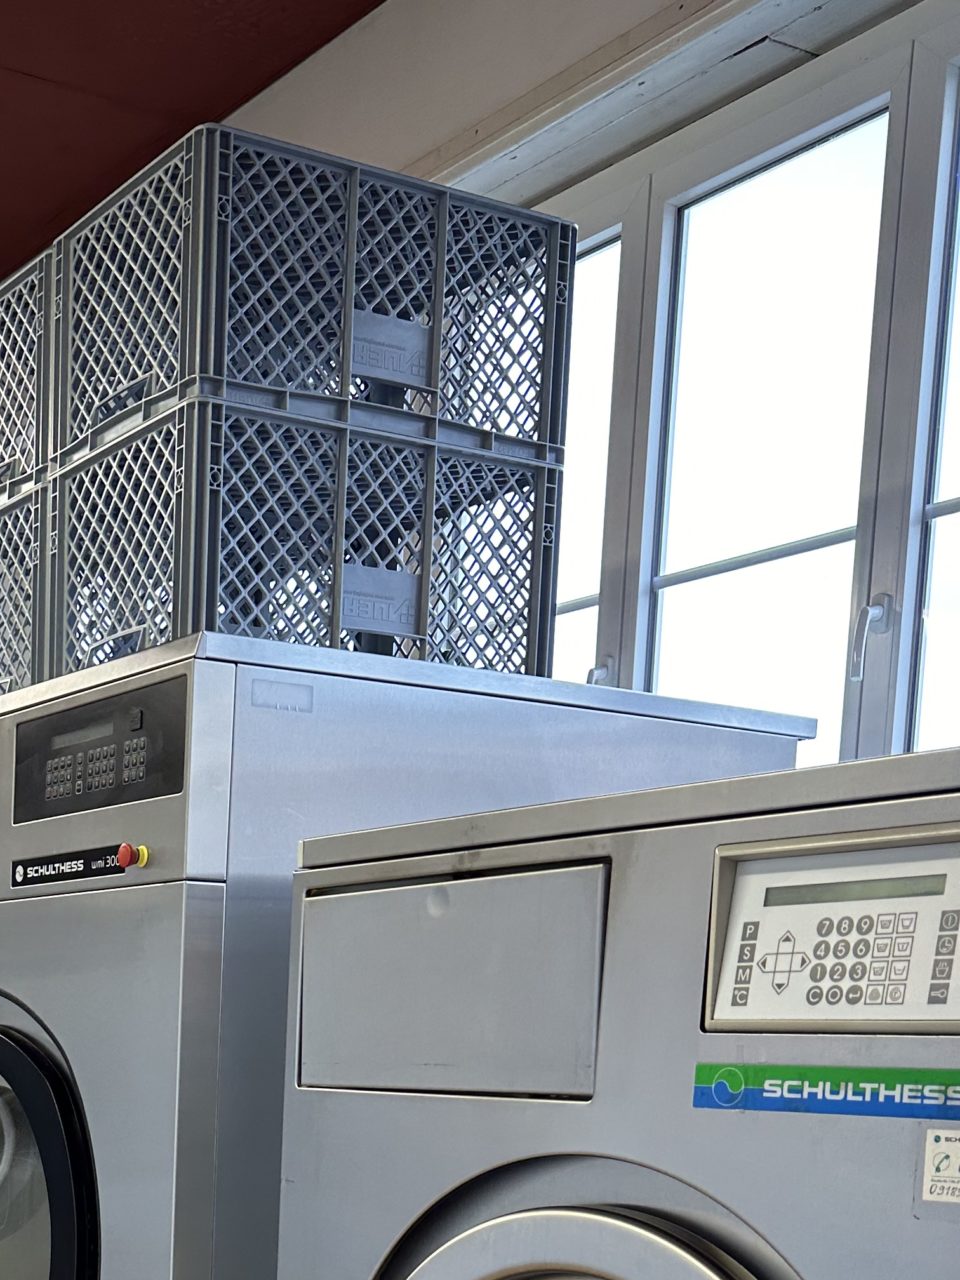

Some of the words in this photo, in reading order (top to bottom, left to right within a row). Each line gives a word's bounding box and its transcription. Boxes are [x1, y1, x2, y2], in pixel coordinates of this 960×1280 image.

[27, 860, 84, 878] SCHULTHESS
[746, 925, 755, 936] P
[822, 921, 829, 933] 7
[842, 920, 849, 932] 8
[861, 919, 869, 932] 9
[743, 948, 750, 960] S
[817, 944, 825, 957] 4
[837, 943, 846, 956] 5
[857, 942, 865, 955] 6
[737, 969, 749, 980] M
[834, 966, 842, 978] 2
[854, 965, 862, 978] 3
[809, 990, 820, 1001] C
[763, 1079, 960, 1106] SCHULTHESS
